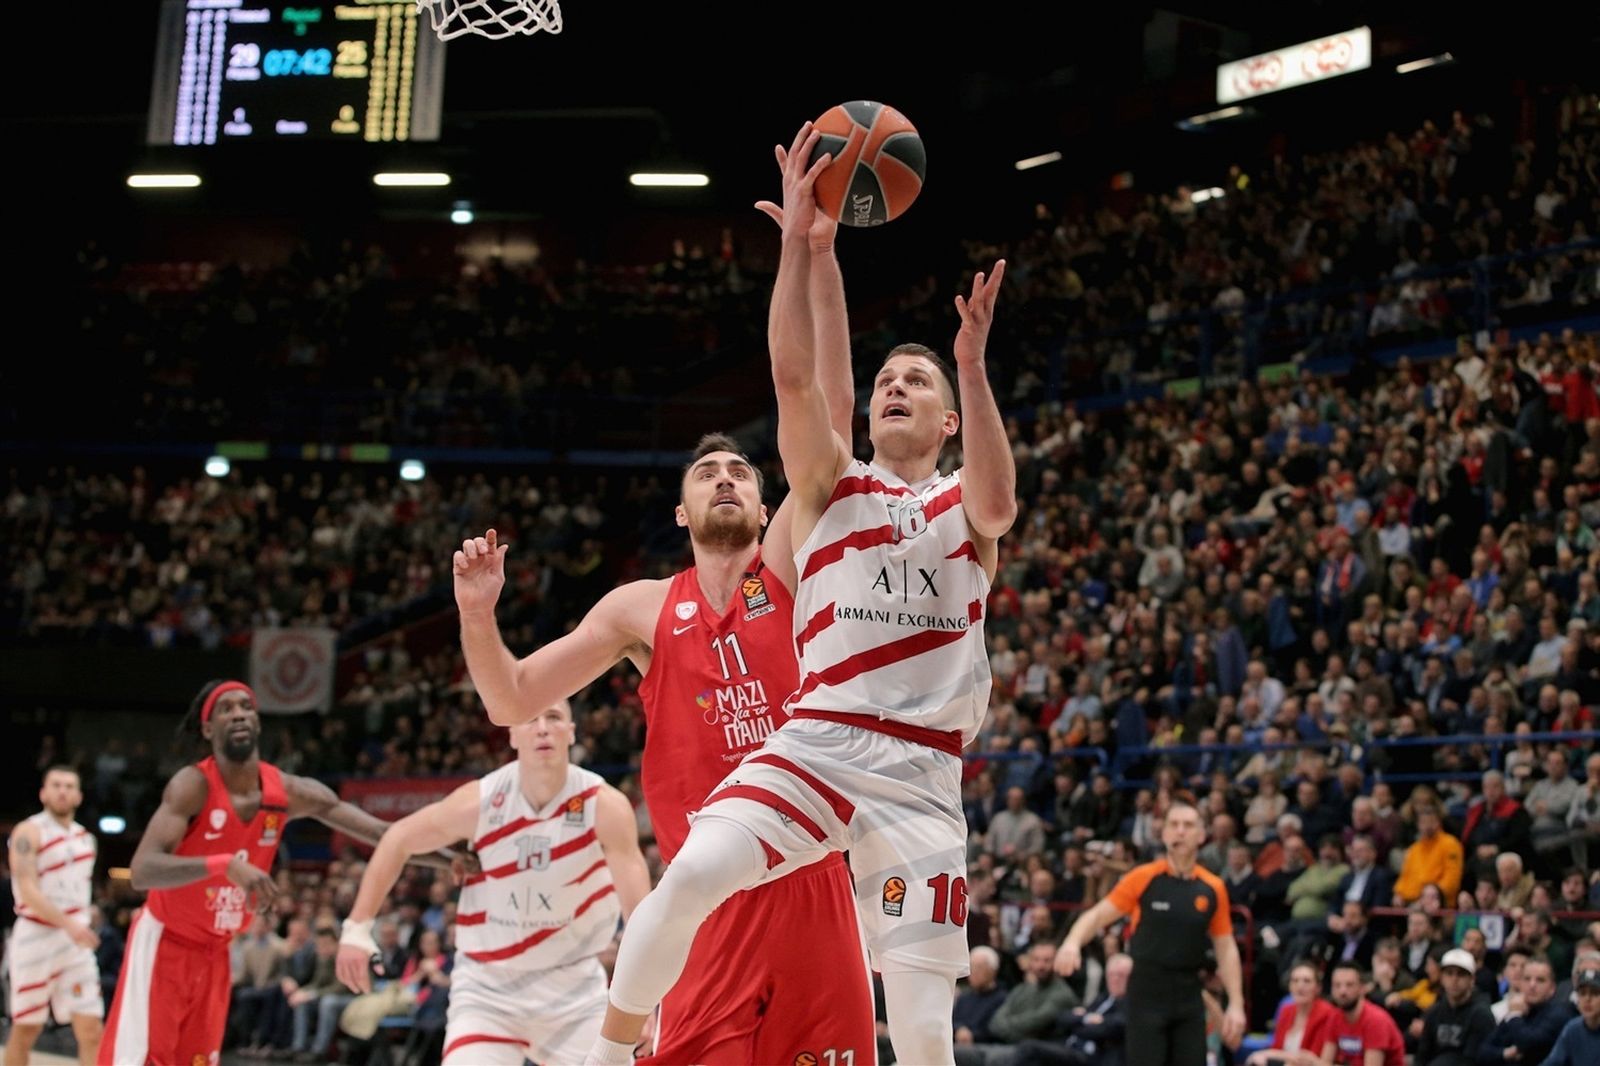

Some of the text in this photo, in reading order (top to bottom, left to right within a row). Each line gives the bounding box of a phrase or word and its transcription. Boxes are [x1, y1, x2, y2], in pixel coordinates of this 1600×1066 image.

[263, 48, 332, 76] 07:42
[835, 607, 890, 624] ARMANI
[711, 631, 749, 680] 11
[514, 834, 551, 872] 15
[927, 872, 968, 928] 16
[823, 1047, 855, 1066] 11
